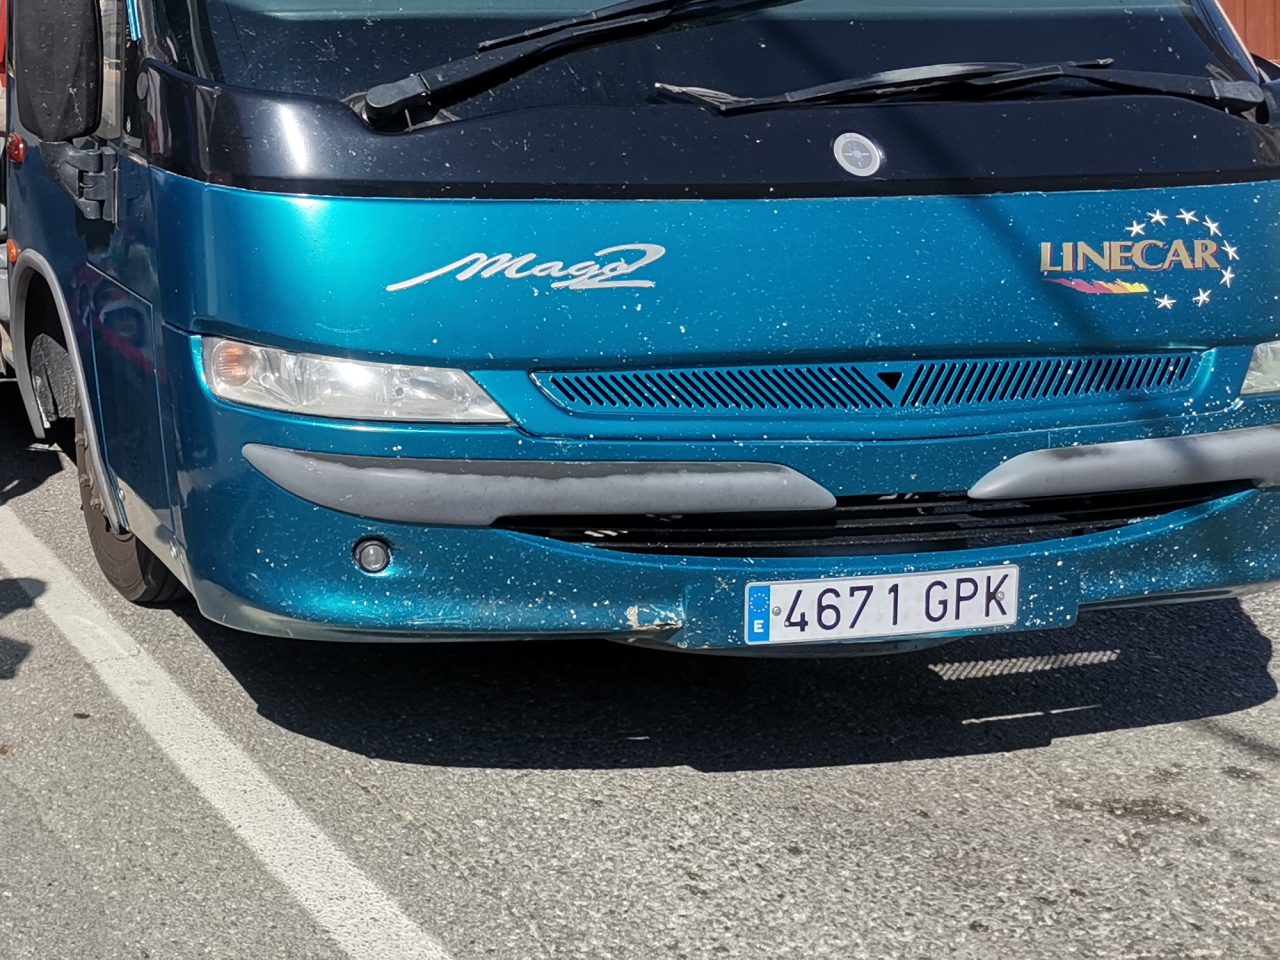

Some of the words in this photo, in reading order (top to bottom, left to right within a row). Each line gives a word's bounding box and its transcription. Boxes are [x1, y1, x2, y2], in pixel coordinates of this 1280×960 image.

[1040, 239, 1221, 272] LINECAR
[753, 619, 764, 632] E
[784, 583, 900, 632] 4671
[924, 574, 1009, 622] GPK
